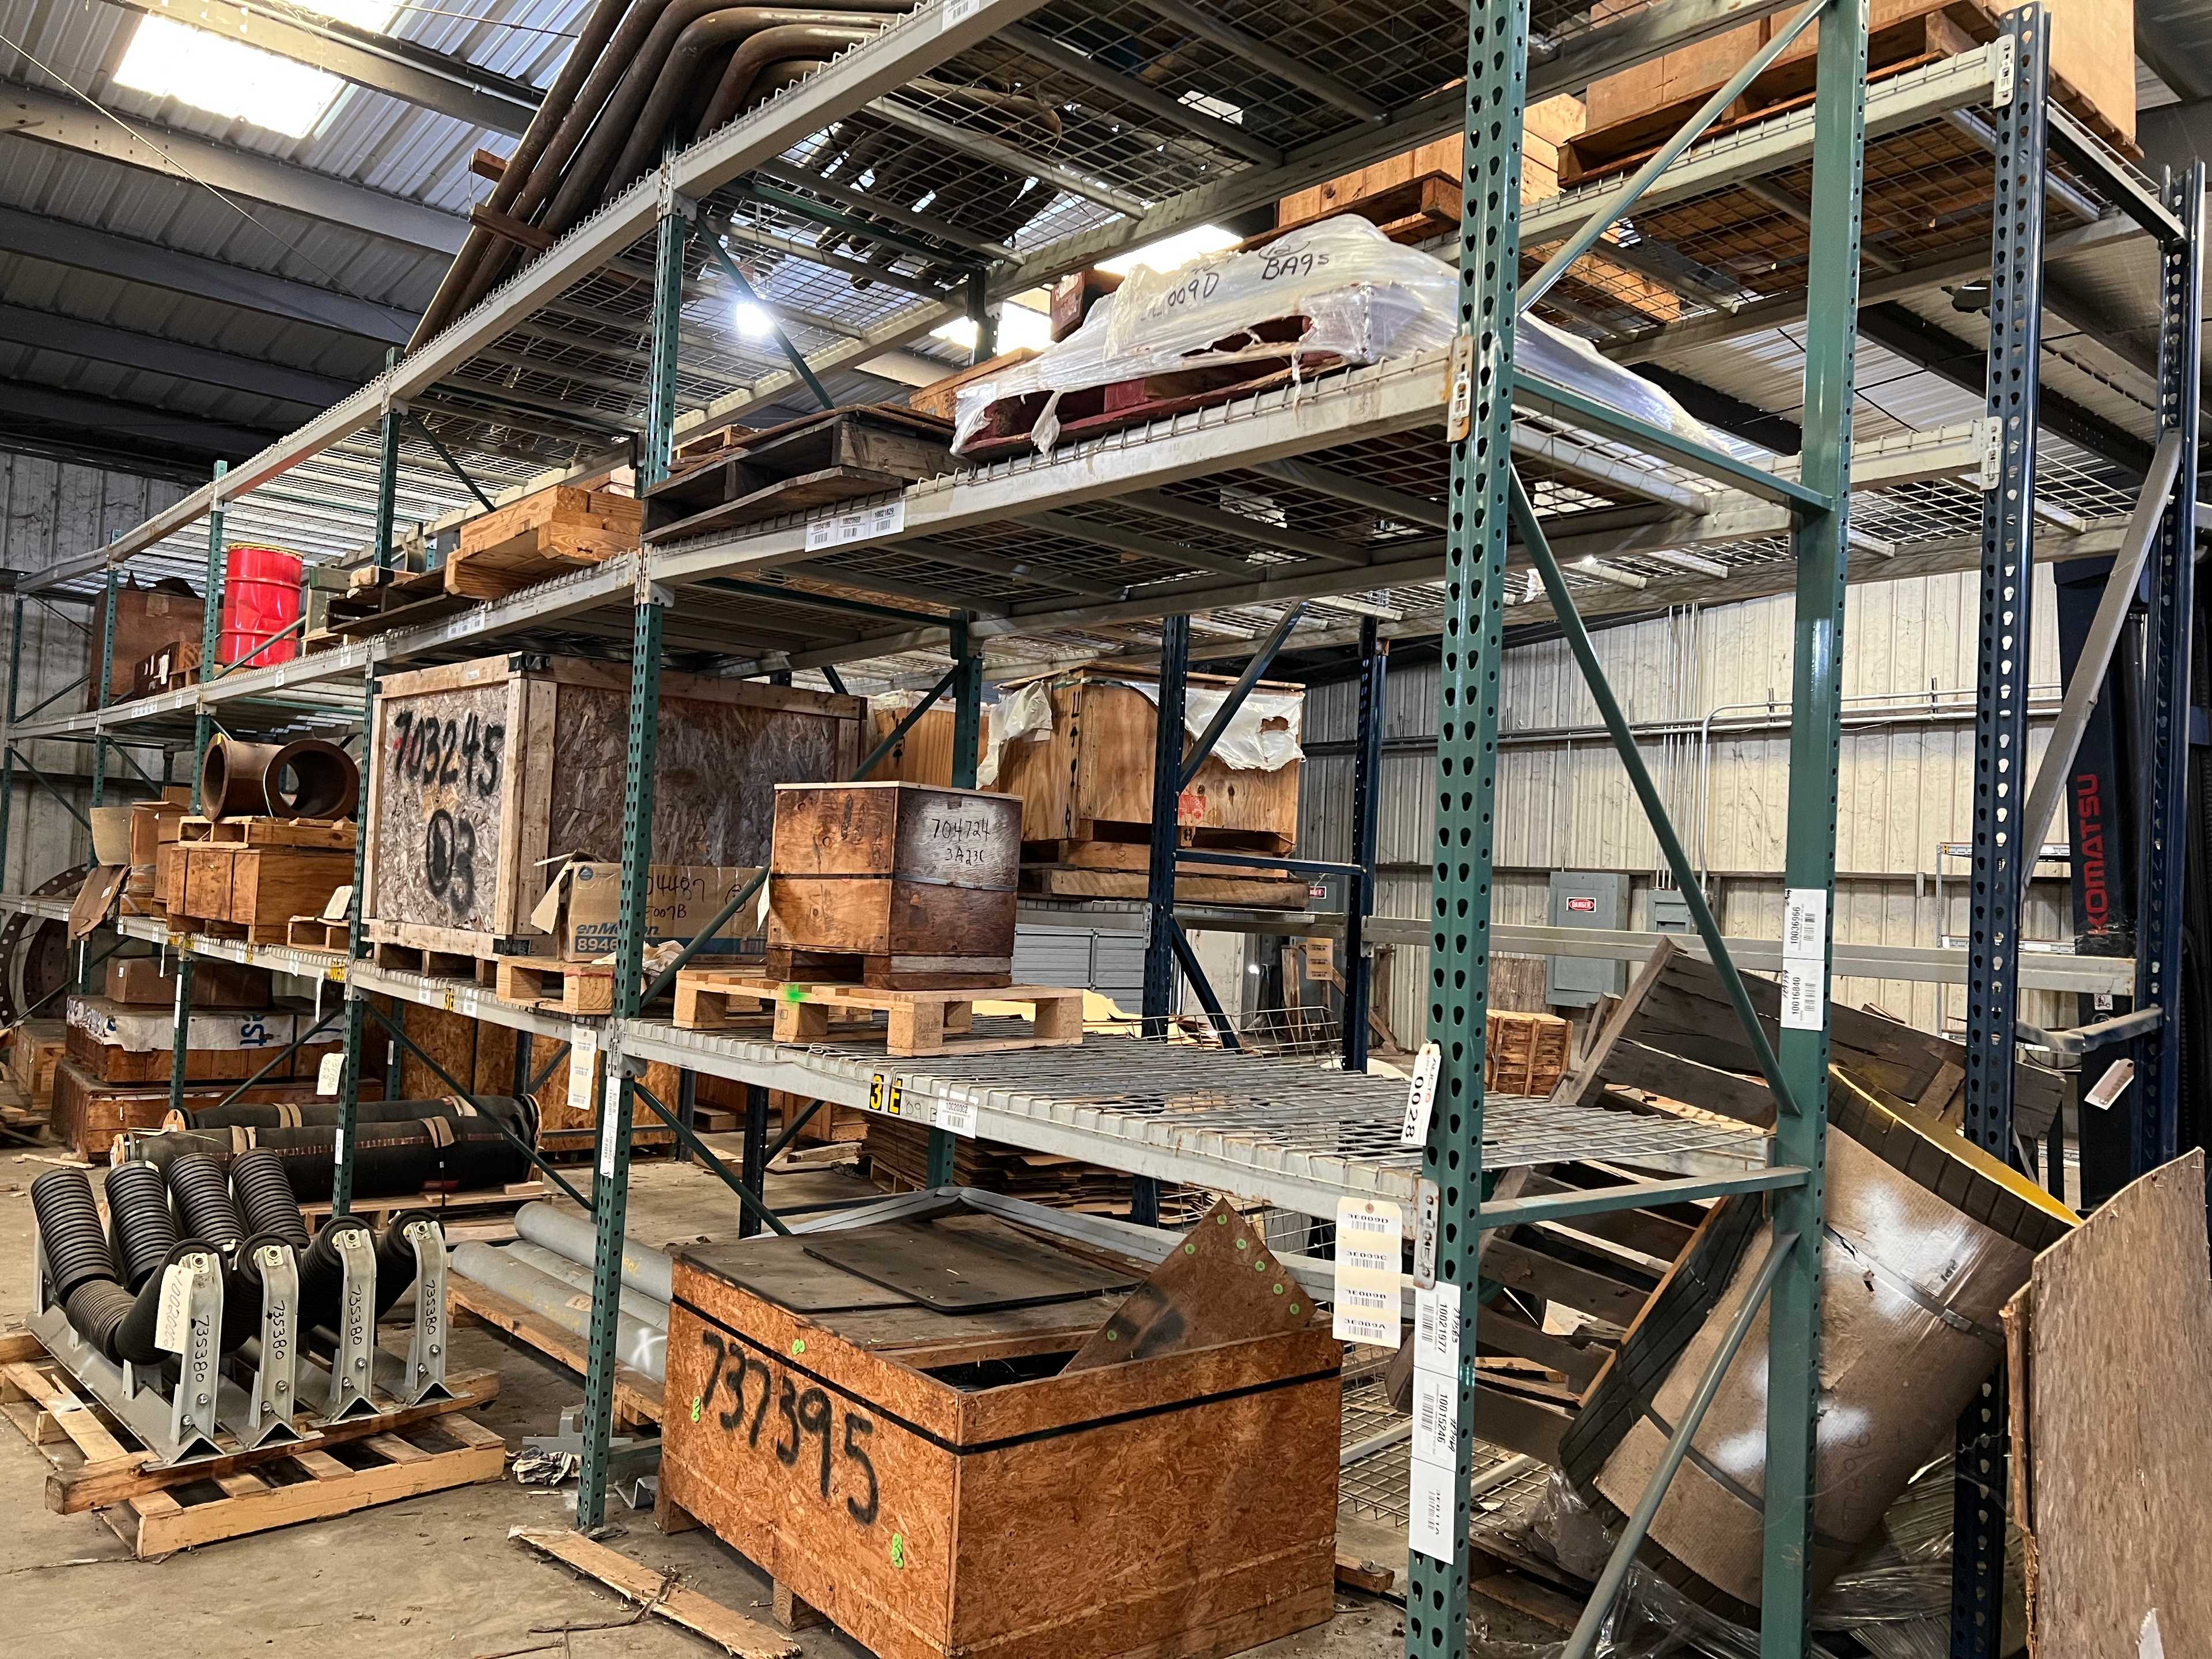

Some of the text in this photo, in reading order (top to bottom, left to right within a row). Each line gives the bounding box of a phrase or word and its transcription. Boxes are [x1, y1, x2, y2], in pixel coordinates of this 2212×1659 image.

[395, 709, 505, 801] 703245
[931, 817, 991, 842] 704724
[2077, 774, 2109, 935] KOMATSU
[1790, 907, 1801, 945] 10036966
[1791, 977, 1801, 1014] 10016840
[946, 1101, 968, 1113] 10020002
[1406, 1076, 1424, 1137] 0028
[272, 1300, 287, 1359] 735380
[349, 1285, 362, 1345] 735380
[425, 1279, 437, 1335] 735380
[1437, 1304, 1448, 1354] 10021977
[194, 1315, 210, 1382] 735380
[702, 1328, 879, 1525] 737395
[1437, 1394, 1448, 1444] 10015246
